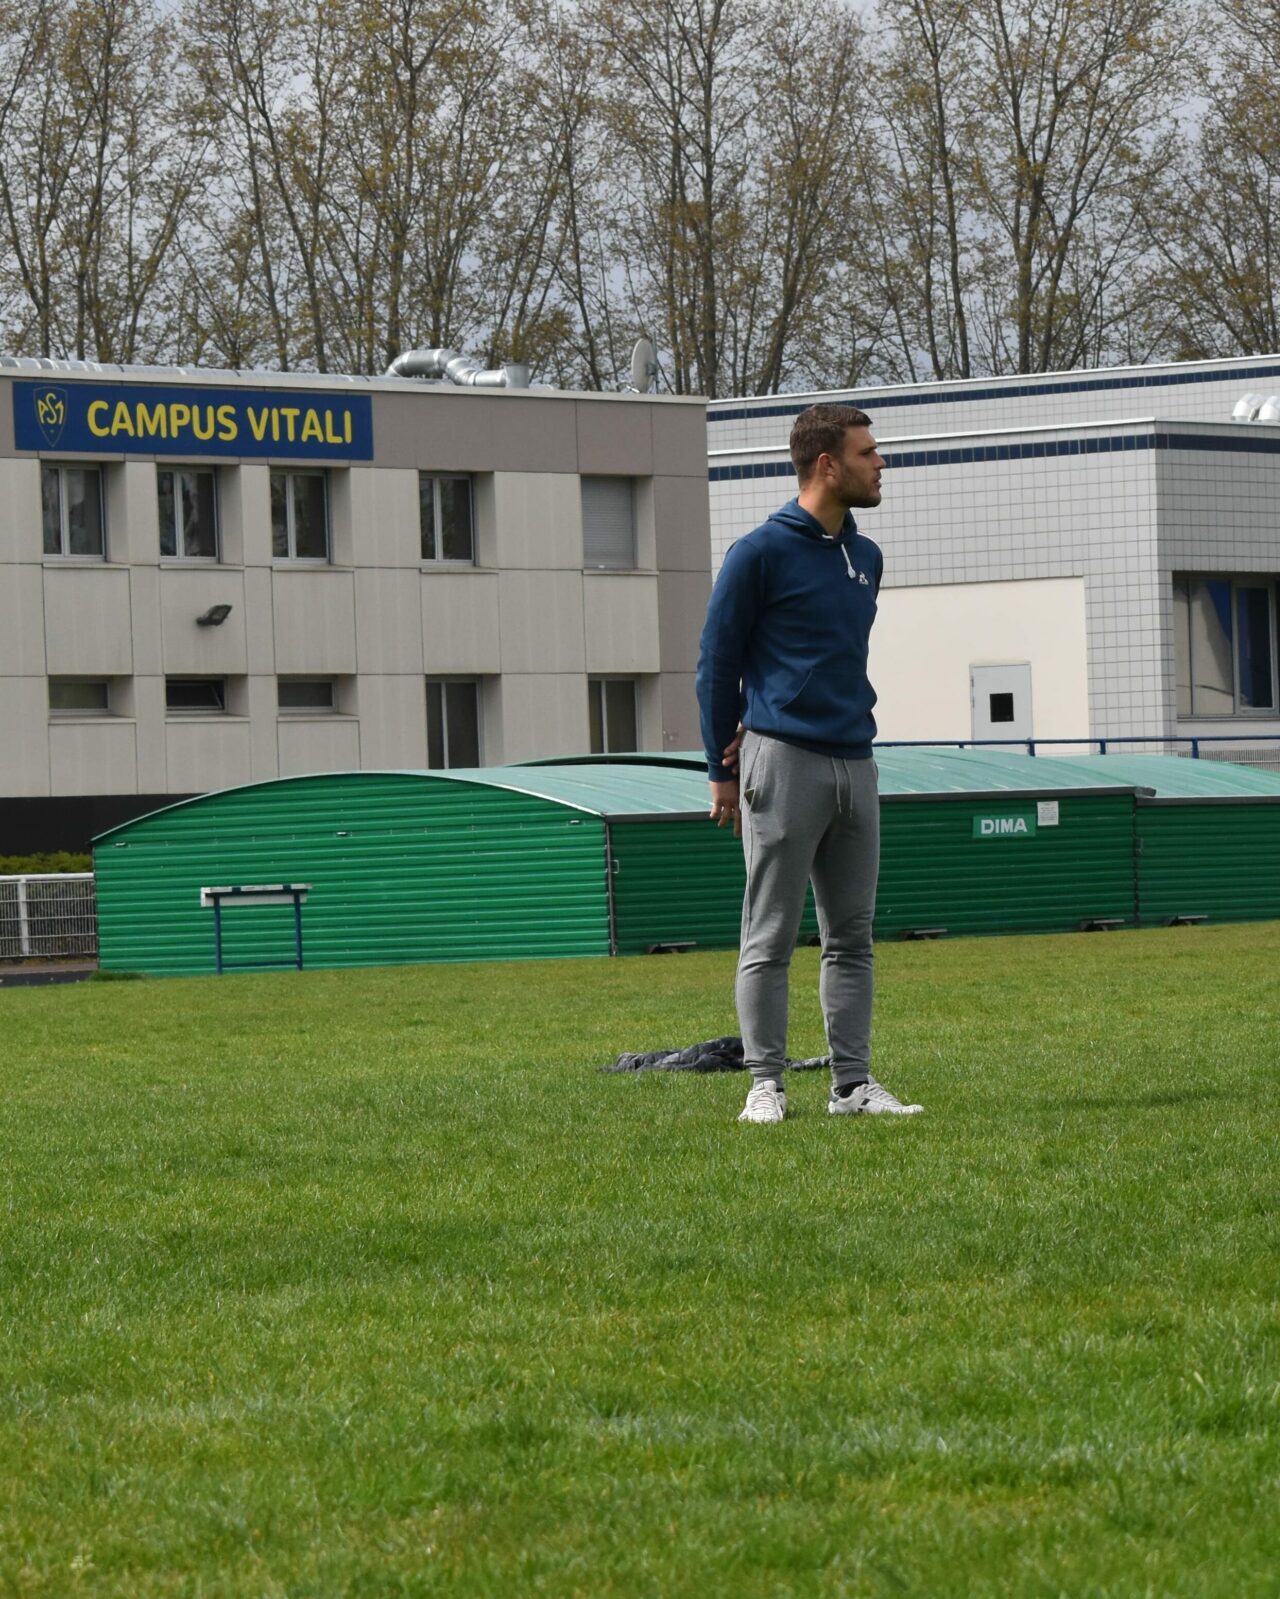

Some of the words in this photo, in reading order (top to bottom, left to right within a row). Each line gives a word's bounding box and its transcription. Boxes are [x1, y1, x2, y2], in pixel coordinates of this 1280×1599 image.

[87, 400, 239, 441] CAMPUS
[247, 407, 352, 444] VITALI
[981, 818, 1028, 834] DIMA
